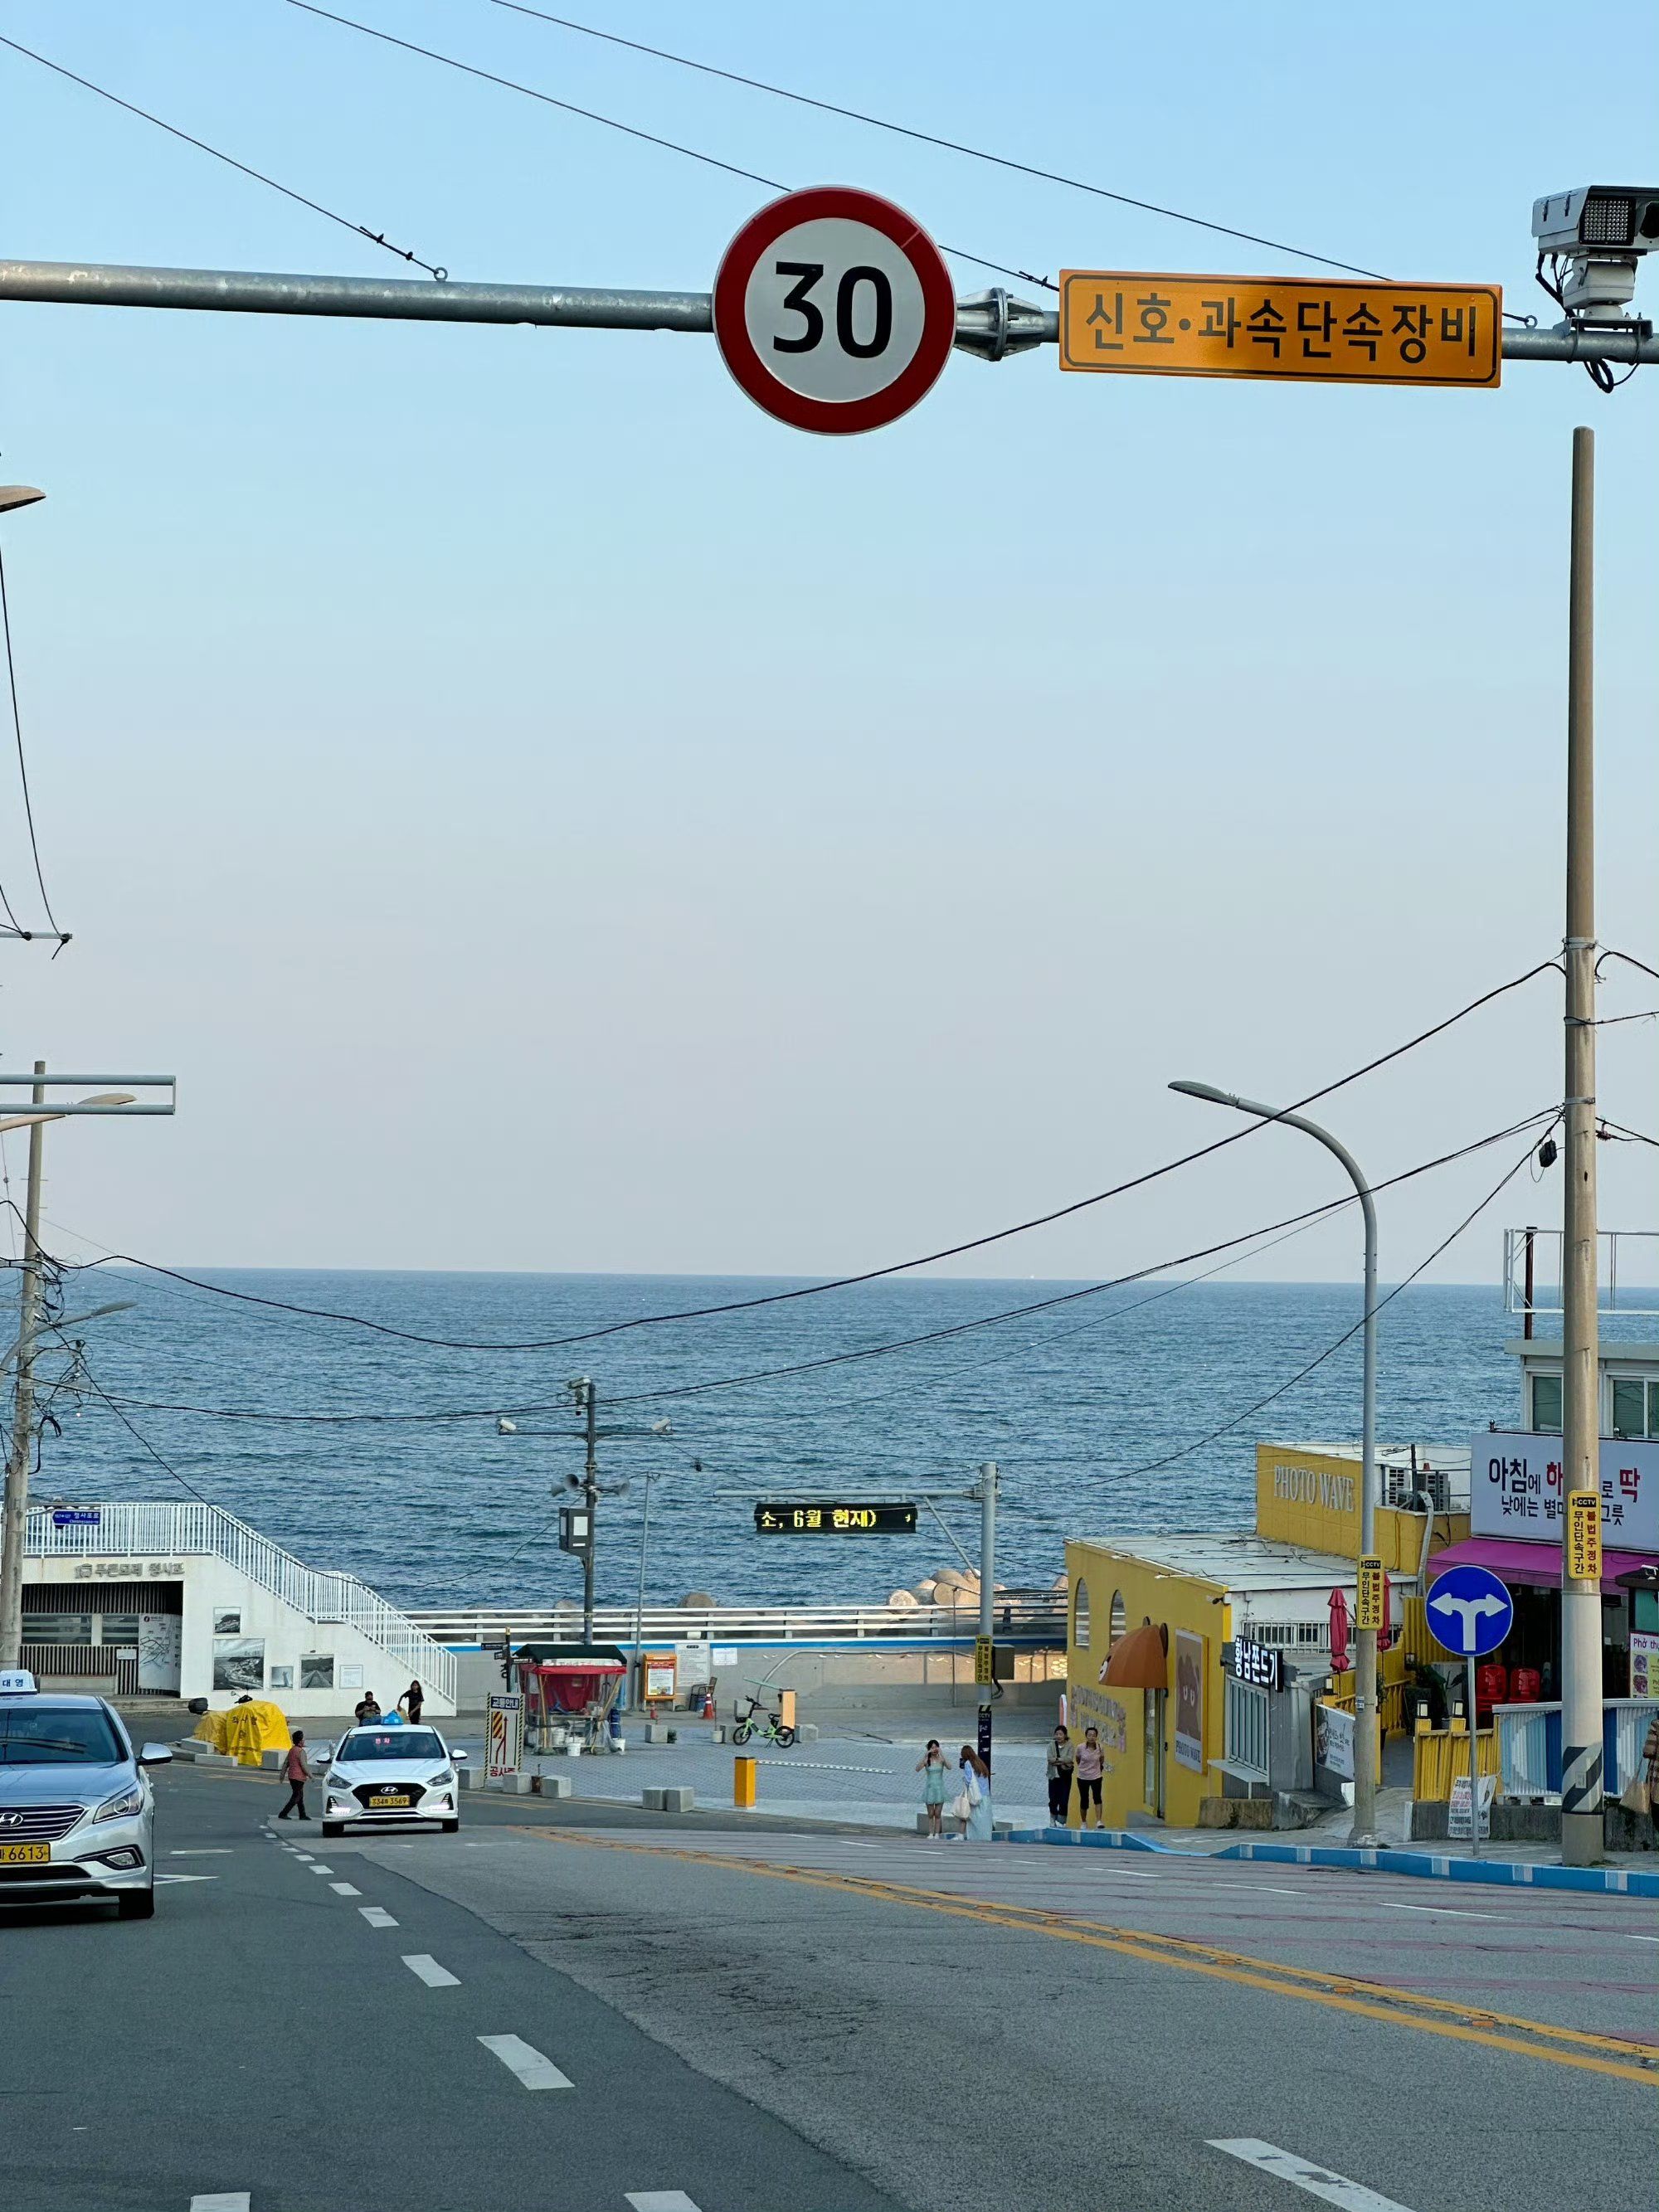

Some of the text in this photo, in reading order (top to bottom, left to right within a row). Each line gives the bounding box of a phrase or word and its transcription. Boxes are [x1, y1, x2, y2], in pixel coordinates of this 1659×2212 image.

[773, 261, 893, 359] 30
[1274, 1465, 1355, 1512] PHOTO WAVE
[1489, 1457, 1541, 1494] 아침에
[1619, 1467, 1641, 1504] 딱
[761, 1509, 877, 1529] 소, 6월 현재)
[1501, 1495, 1539, 1518] 낮에는
[1574, 1511, 1584, 1574] 무인단속구간
[1587, 1511, 1597, 1574] 불법주정차
[1361, 1572, 1370, 1624] 무인단속구간
[1372, 1572, 1380, 1625] 불법주정차
[492, 1698, 518, 1709] 교통안내
[390, 1797, 407, 1806] 3569
[9, 1846, 44, 1860] 6613
